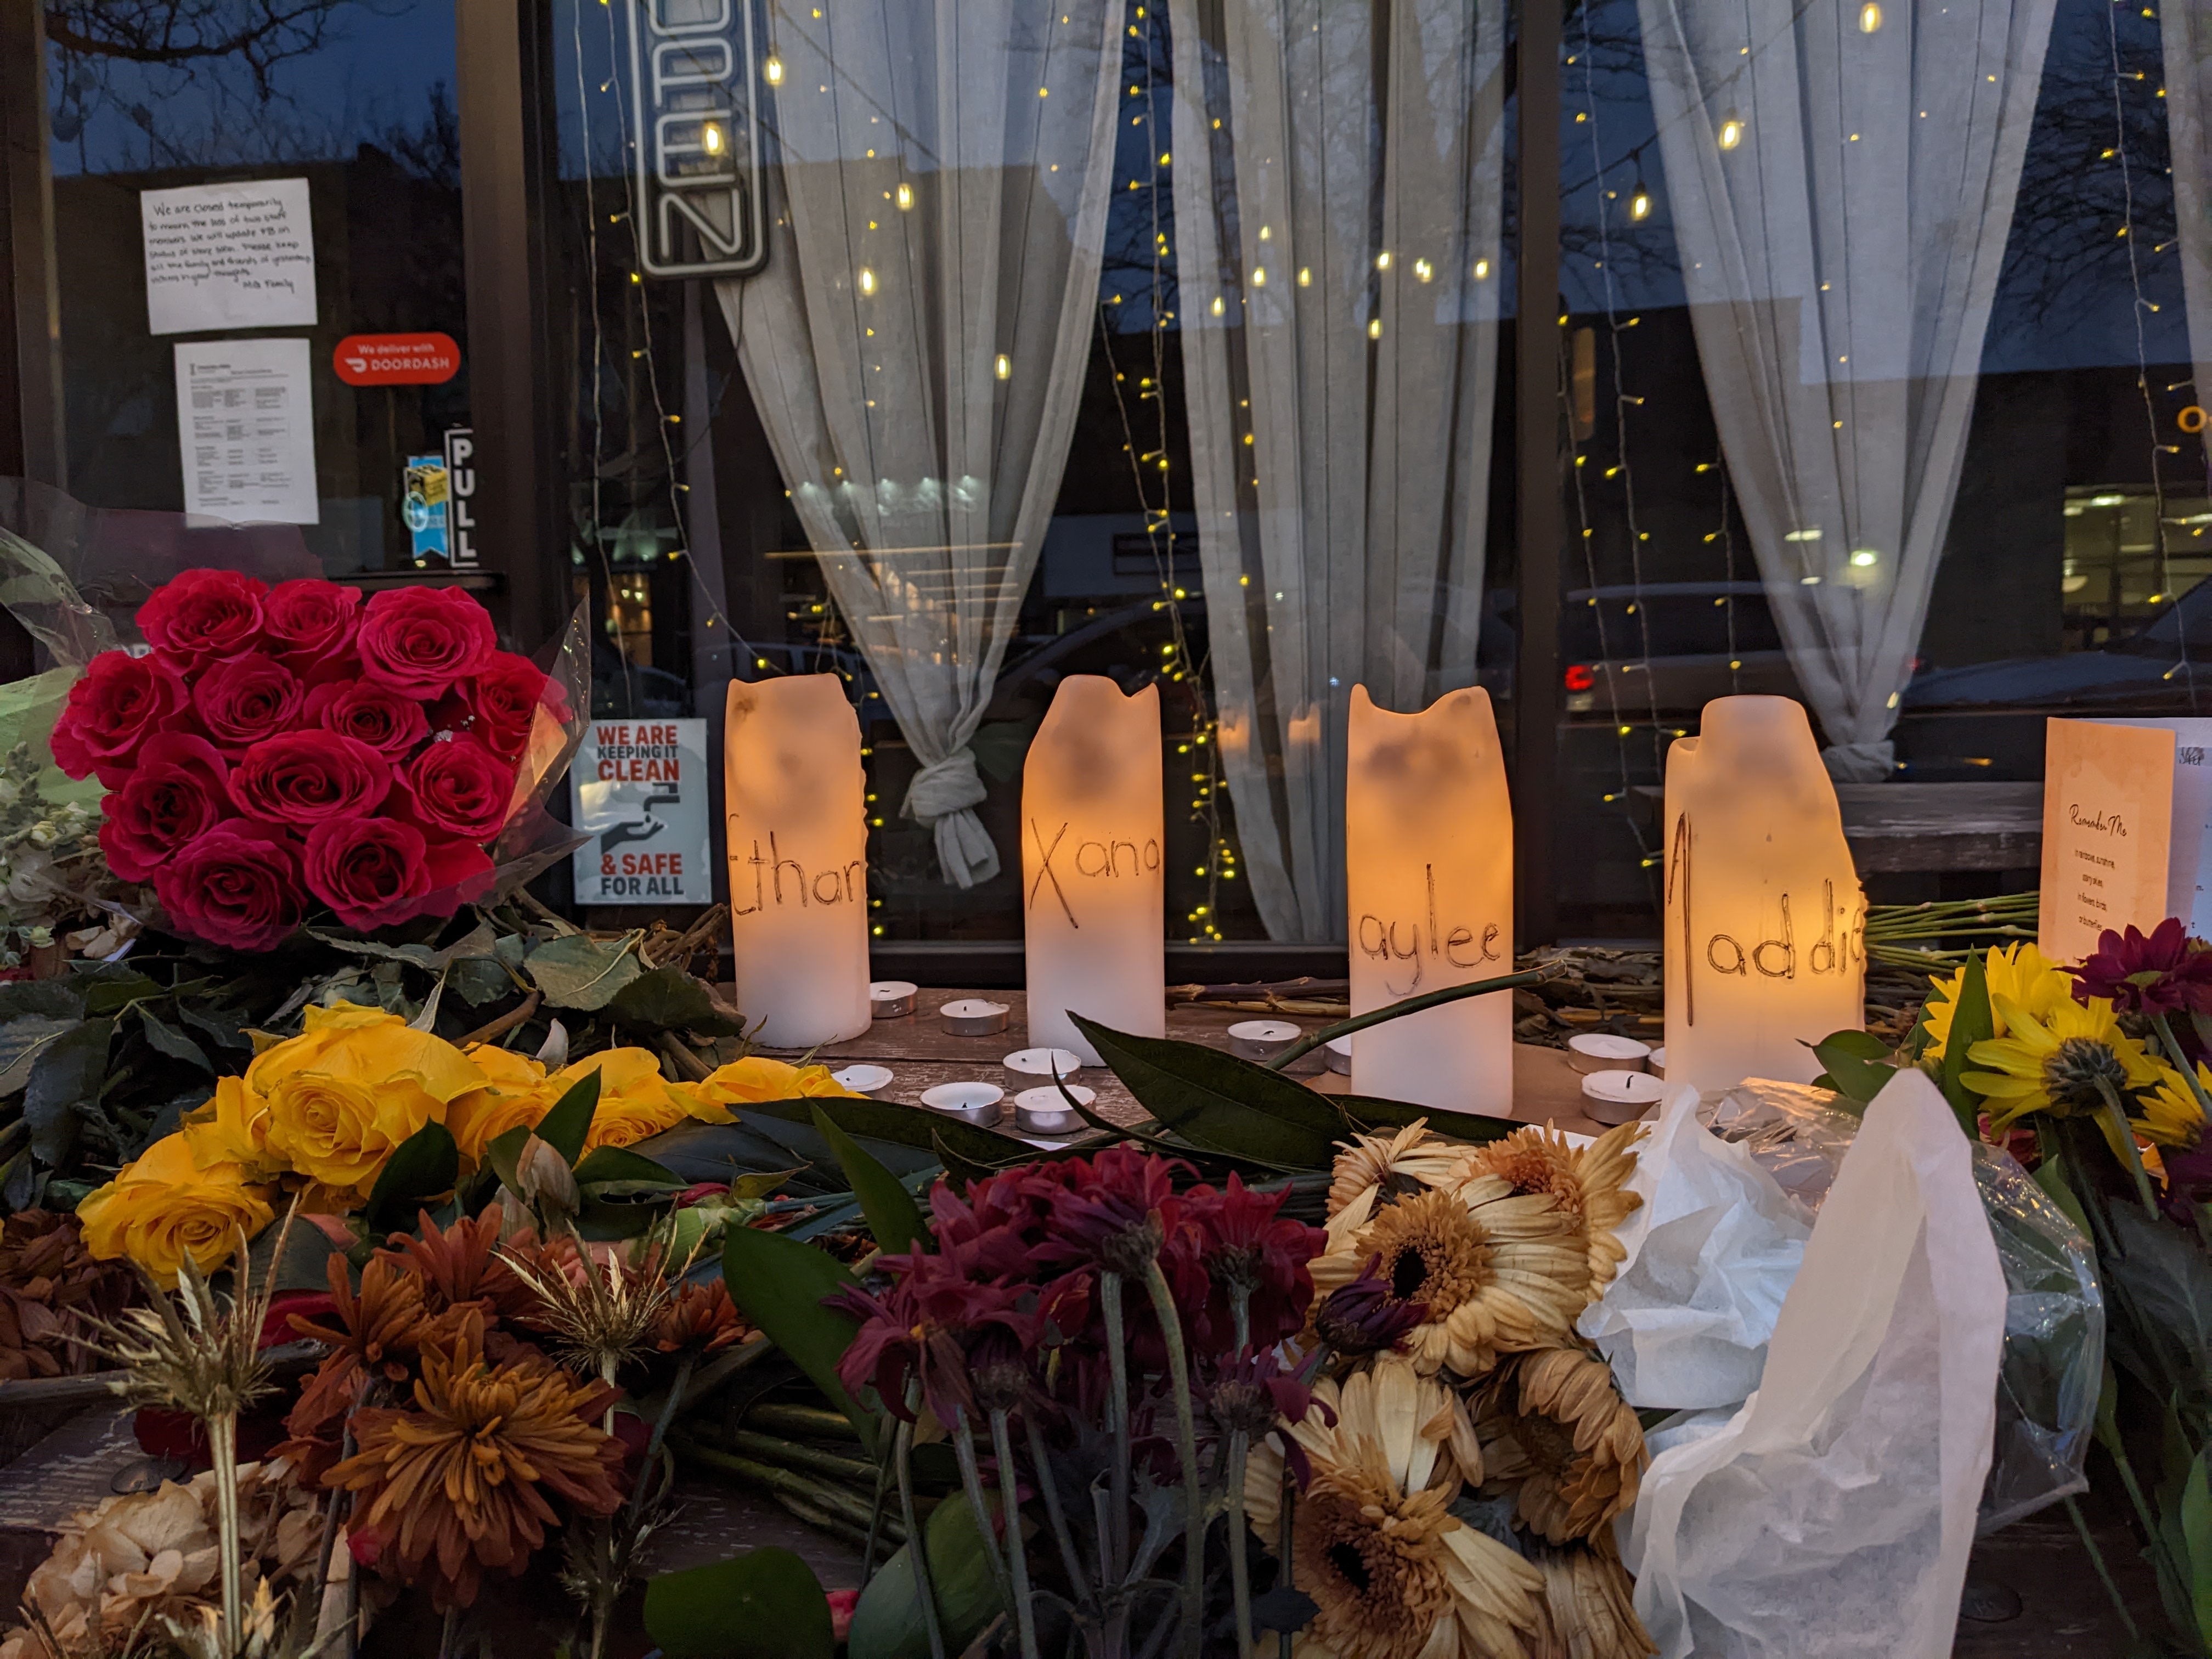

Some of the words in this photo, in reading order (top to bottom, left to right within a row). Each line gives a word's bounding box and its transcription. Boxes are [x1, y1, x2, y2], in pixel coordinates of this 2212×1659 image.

[154, 201, 171, 216] We
[175, 205, 191, 214] are
[194, 201, 224, 214] closed
[358, 344, 375, 355] We
[377, 343, 410, 354] deliver
[413, 343, 436, 353] with
[371, 357, 450, 371] DOORDASH
[453, 438, 477, 558] PULL
[596, 725, 630, 745] WE
[635, 724, 678, 744] ARE
[597, 746, 661, 759] KEEPING
[665, 745, 679, 758] IT
[598, 759, 680, 781] CLEAN
[2069, 804, 2107, 831] Remember
[2107, 815, 2128, 837] Me
[600, 853, 618, 876] &
[622, 853, 683, 875] SAFE
[601, 877, 642, 895] FOR
[646, 876, 685, 895] ALL
[1358, 863, 1501, 997] aylee
